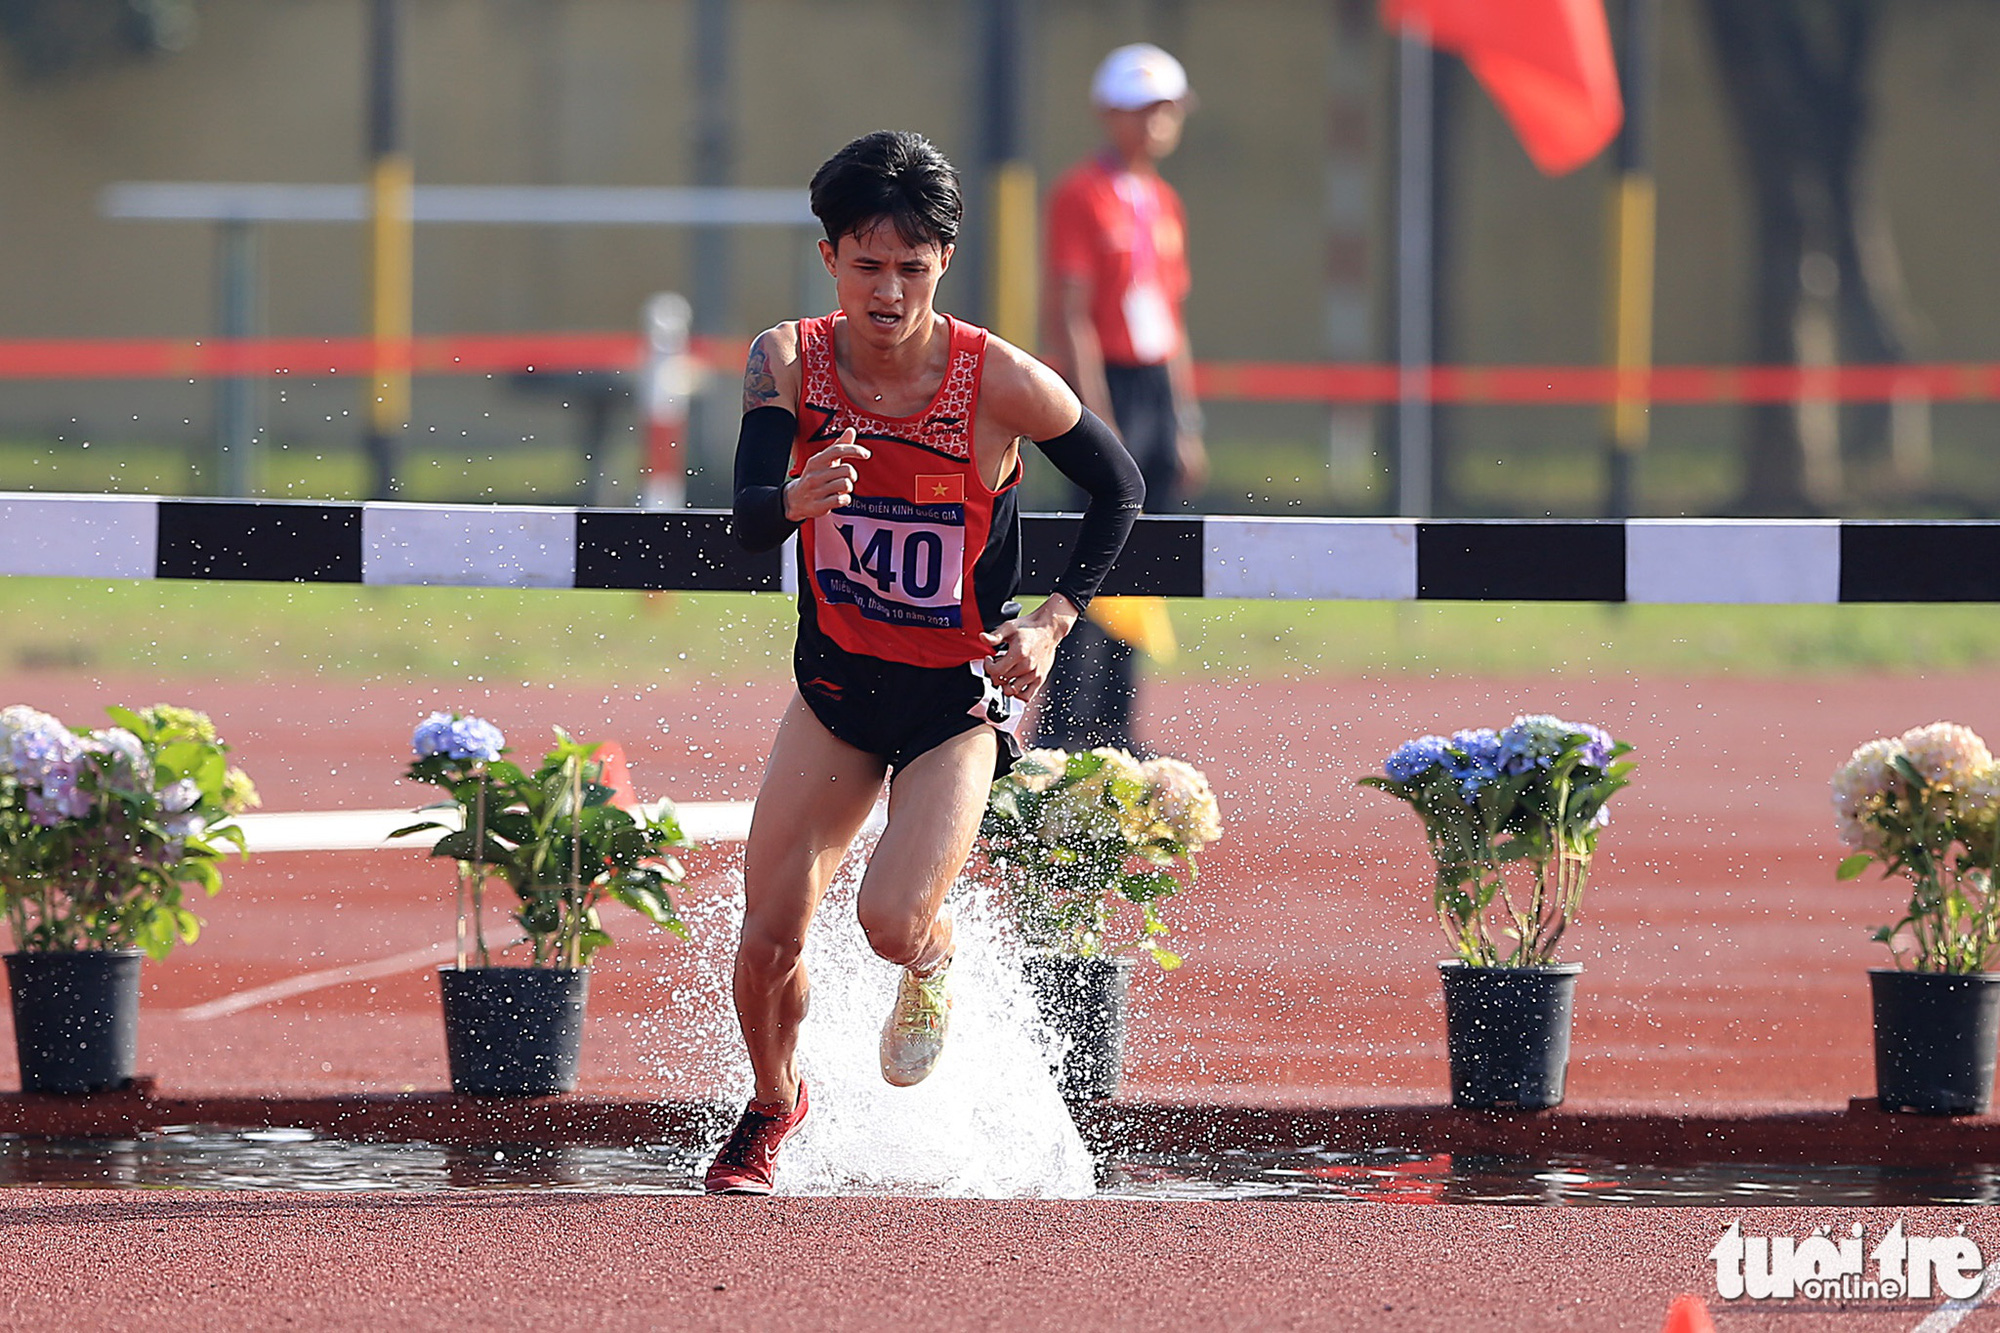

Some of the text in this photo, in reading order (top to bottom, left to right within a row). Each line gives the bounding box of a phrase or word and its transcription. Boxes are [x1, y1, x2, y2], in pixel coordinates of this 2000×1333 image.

[892, 505, 913, 515] KINH
[942, 510, 957, 520] GIA
[834, 523, 942, 599] 140
[893, 609, 903, 619] 10
[927, 615, 950, 627] 2023
